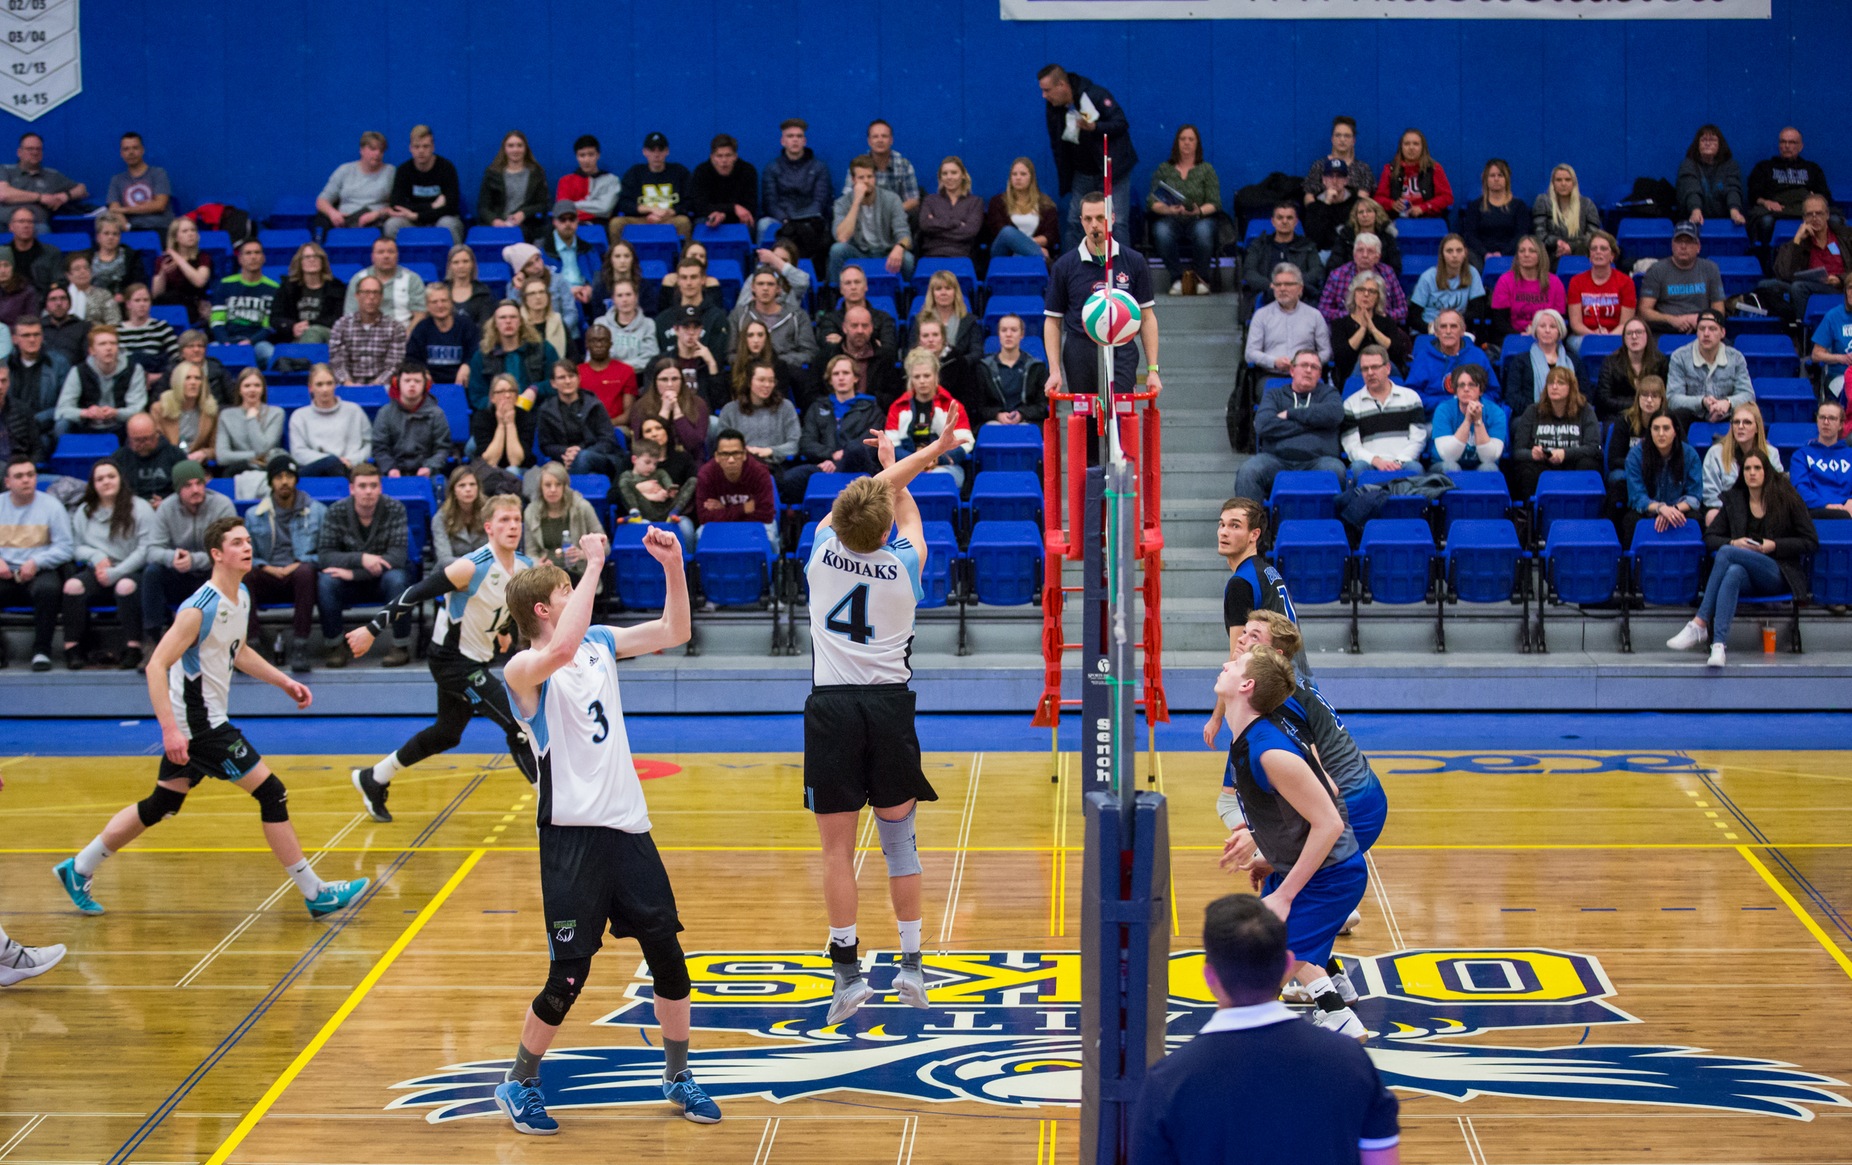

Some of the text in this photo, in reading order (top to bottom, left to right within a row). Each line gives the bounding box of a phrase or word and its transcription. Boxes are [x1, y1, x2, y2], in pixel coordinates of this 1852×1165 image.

[8, 31, 46, 43] 03/04
[12, 62, 47, 75] 12/13
[13, 92, 48, 105] 14-15
[822, 549, 898, 580] KODIAKS
[825, 582, 876, 645] 4
[588, 699, 609, 744] 3
[1096, 718, 1110, 782] senoh
